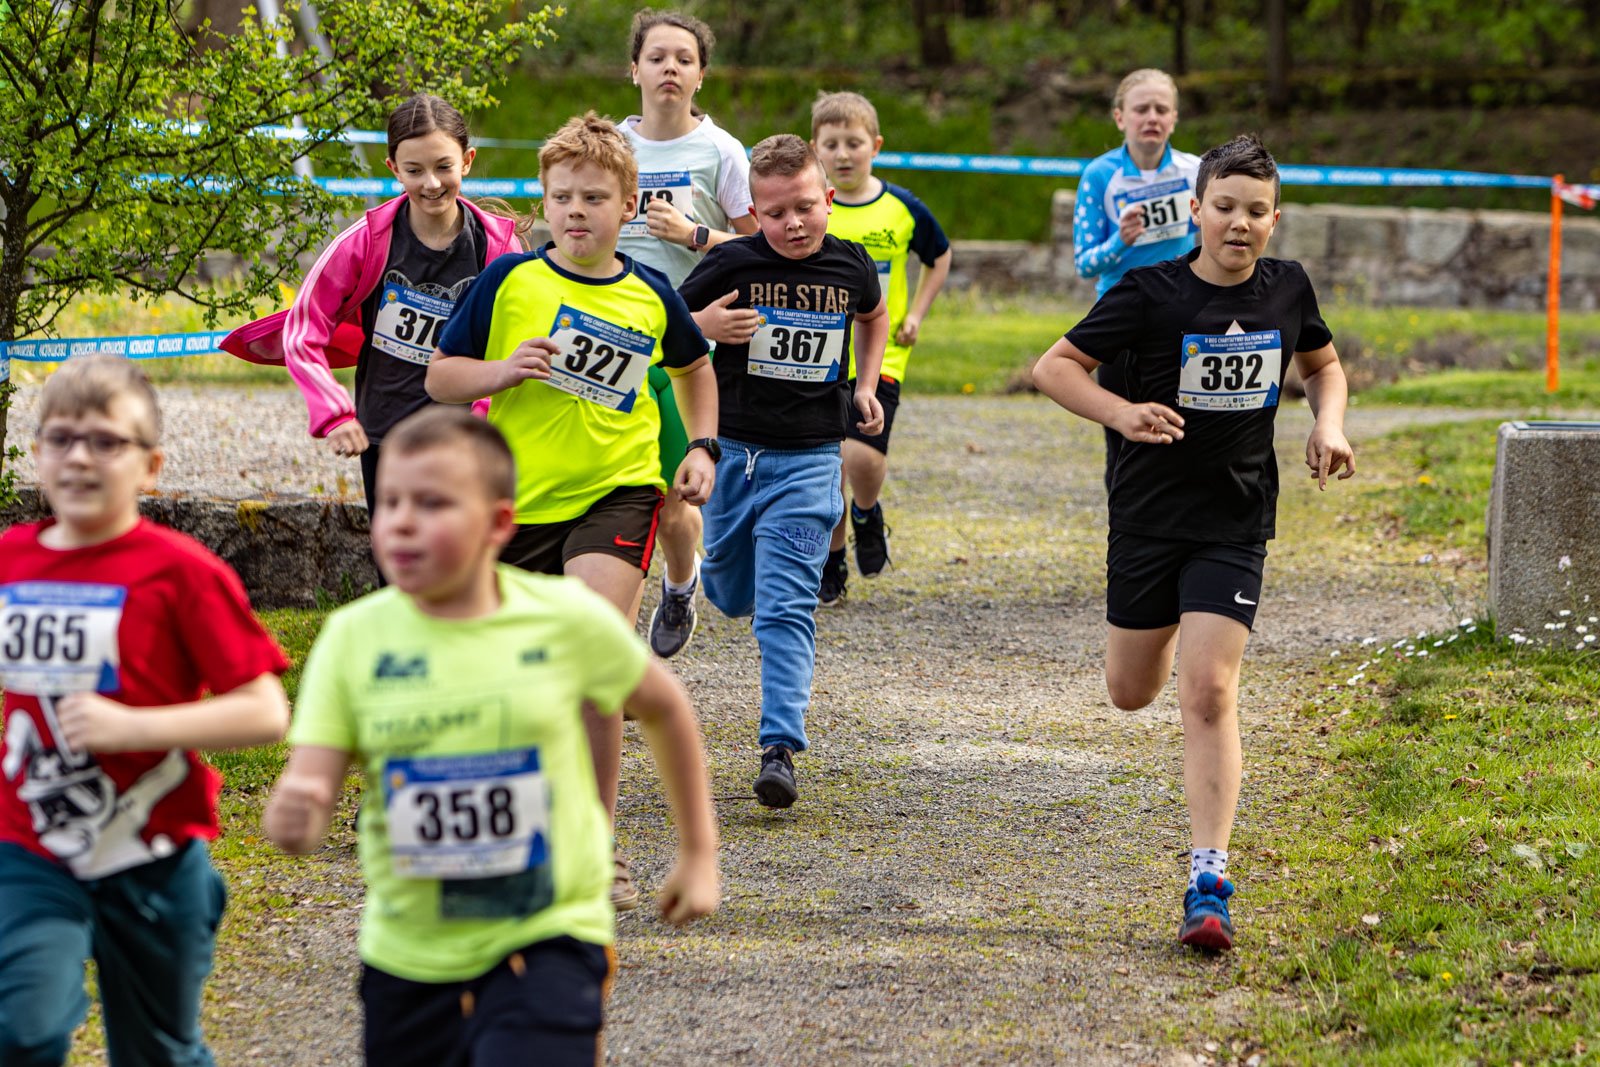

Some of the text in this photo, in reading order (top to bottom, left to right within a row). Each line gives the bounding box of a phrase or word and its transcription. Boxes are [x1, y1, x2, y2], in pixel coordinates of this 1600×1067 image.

[1141, 197, 1178, 228] 351
[750, 283, 849, 314] BIG STAR
[565, 334, 632, 386] 327
[770, 328, 828, 364] 367
[1201, 354, 1262, 390] 332
[3, 613, 86, 662] 365
[414, 786, 516, 844] 358
